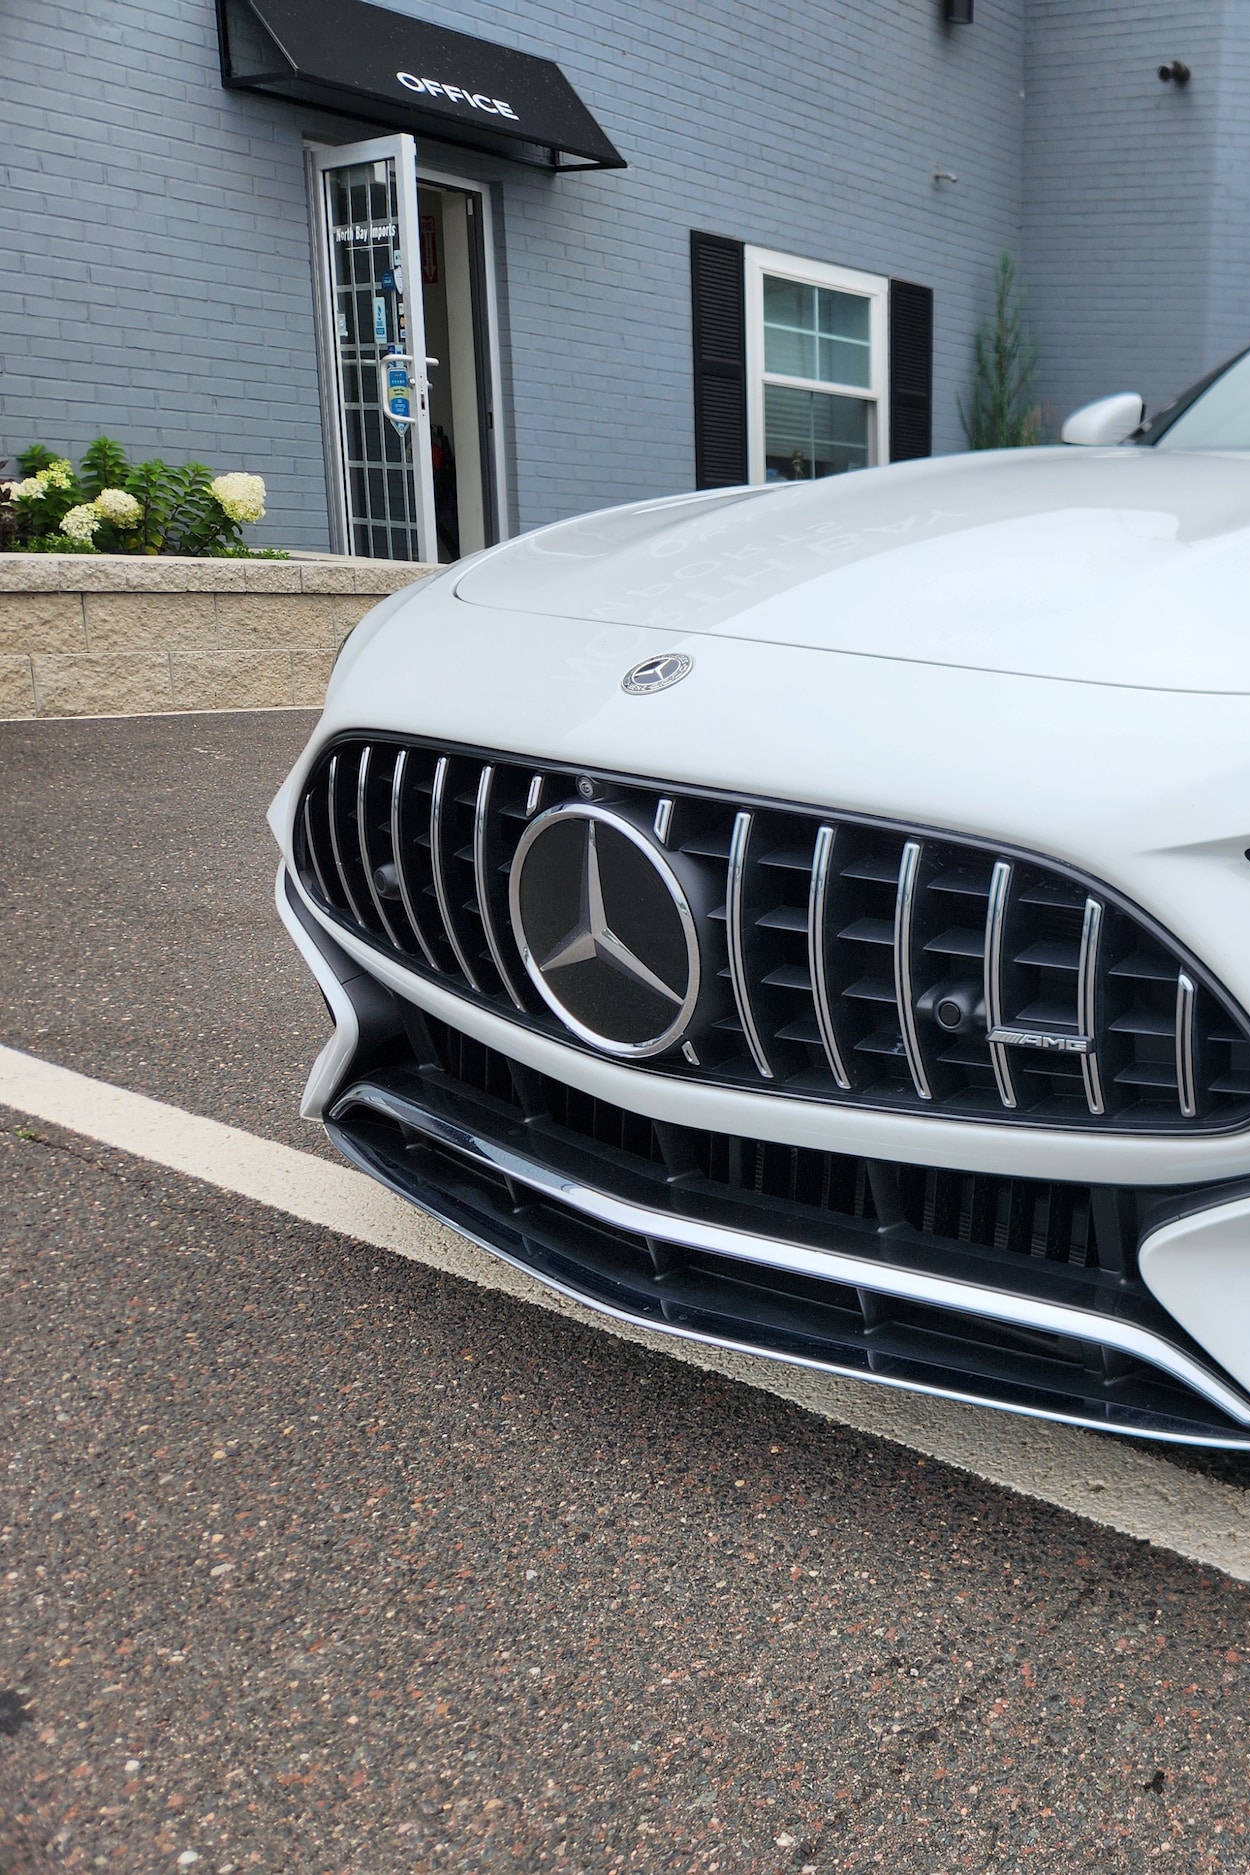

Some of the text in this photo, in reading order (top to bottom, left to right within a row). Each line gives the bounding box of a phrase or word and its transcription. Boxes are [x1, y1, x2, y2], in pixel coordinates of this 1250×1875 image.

[396, 71, 520, 120] OFFICE
[336, 227, 354, 242] North
[355, 225, 368, 242] Bay
[1019, 1034, 1087, 1052] AMG
